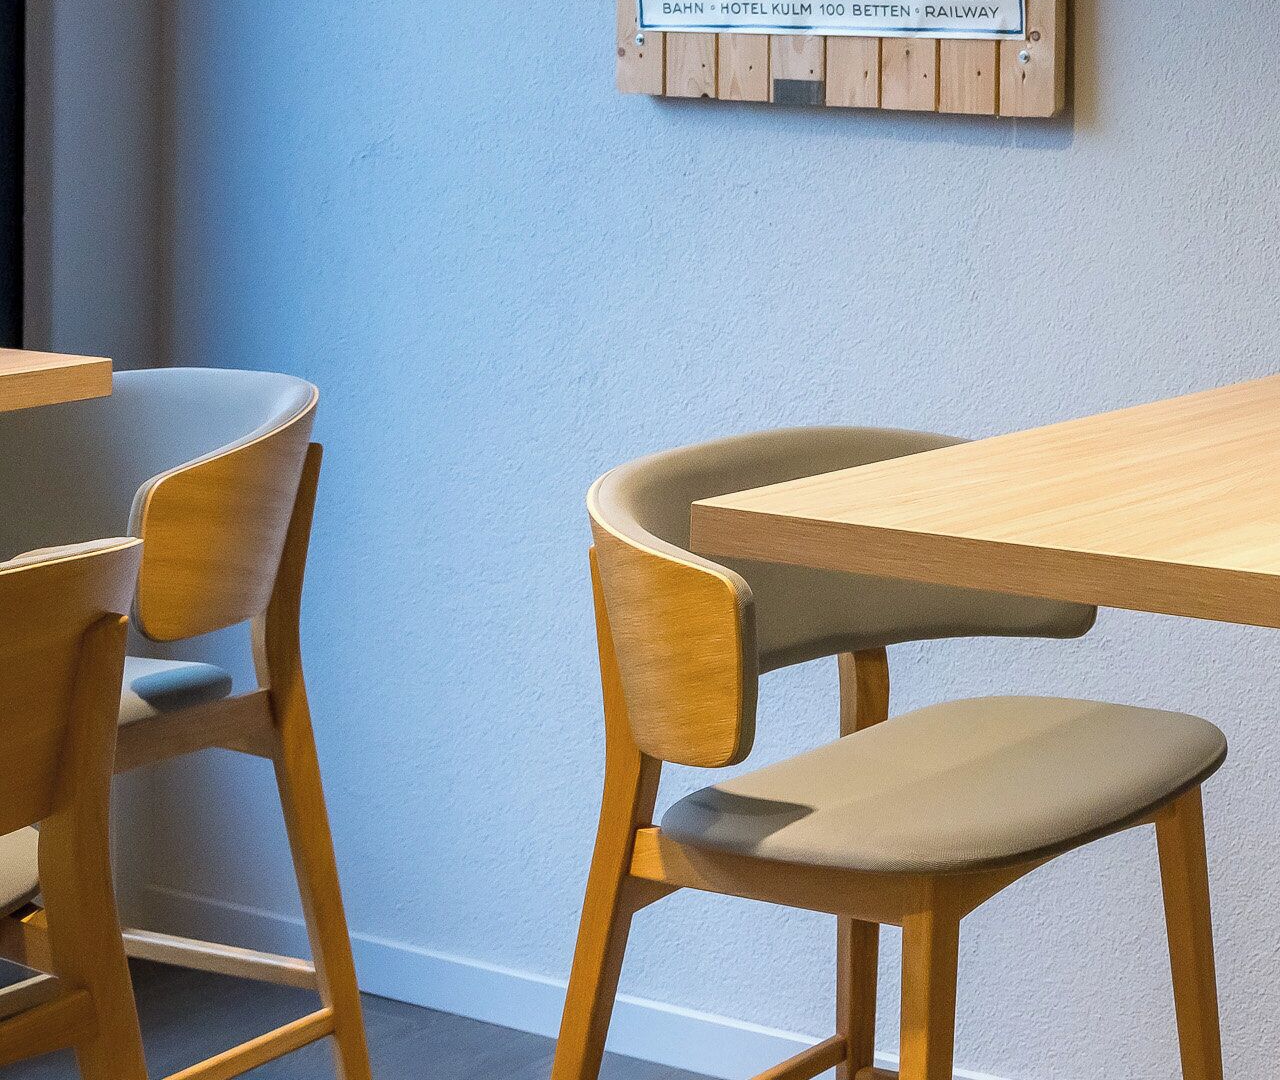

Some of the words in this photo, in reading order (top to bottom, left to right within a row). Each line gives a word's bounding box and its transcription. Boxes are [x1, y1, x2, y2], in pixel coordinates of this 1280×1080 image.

[662, 2, 704, 15] BAHN
[720, 2, 768, 15] HOTEL
[772, 3, 812, 15] KULM
[819, 3, 845, 16] 100
[852, 4, 911, 17] BETTEN
[925, 5, 999, 19] RAILWAY
